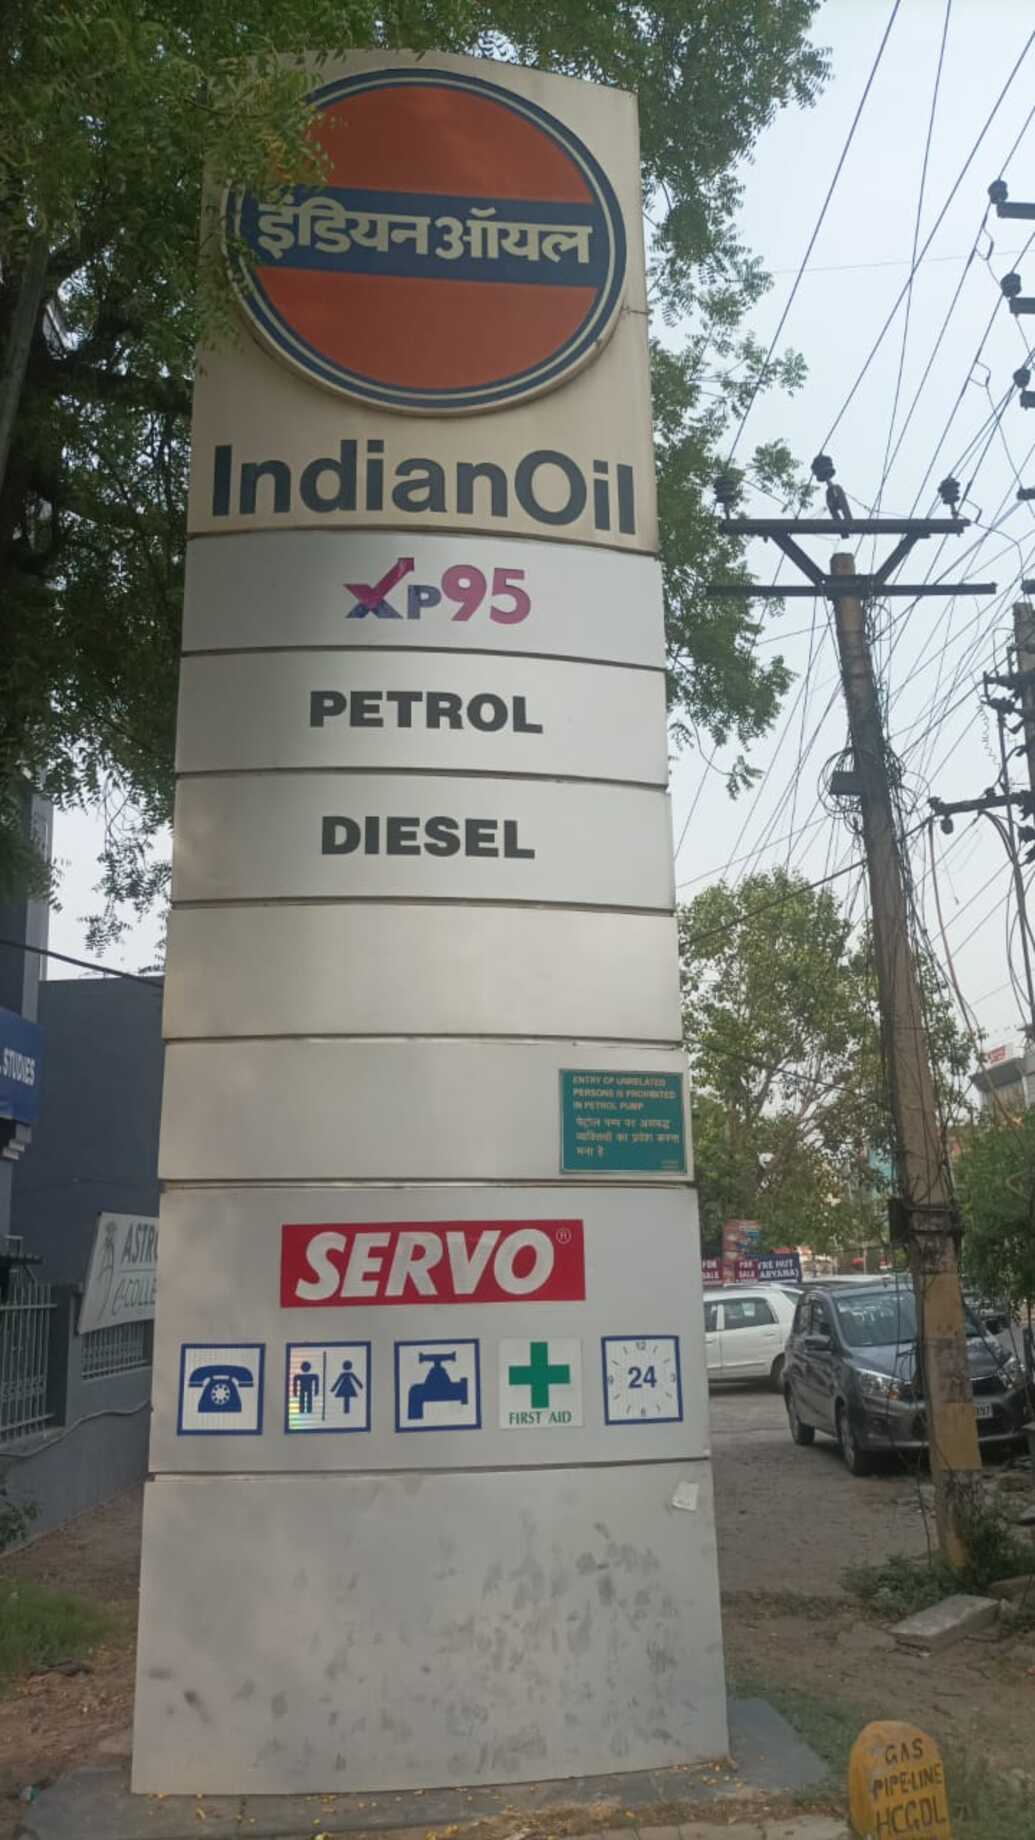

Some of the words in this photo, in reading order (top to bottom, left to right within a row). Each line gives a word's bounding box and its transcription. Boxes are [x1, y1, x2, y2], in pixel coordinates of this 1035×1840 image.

[212, 438, 636, 535] IndianOil
[310, 690, 543, 734] PETROL
[321, 816, 535, 859] DIESEL
[3, 1048, 36, 1086] STUDIES
[573, 1075, 601, 1085] ENTRY
[603, 1076, 614, 1085] OF
[573, 1088, 614, 1098] PERSONS
[616, 1089, 624, 1098] IS
[626, 1089, 676, 1099] PROHIBITED
[573, 1101, 582, 1110] IN
[584, 1101, 617, 1111] PETROL
[619, 1102, 644, 1111] PUMP
[295, 1228, 555, 1300] SERVO
[628, 1366, 658, 1389] 24
[508, 1411, 543, 1425] FIRST
[549, 1410, 572, 1424] AID
[884, 1737, 923, 1765] GAS
[872, 1762, 943, 1801] PIPELINE
